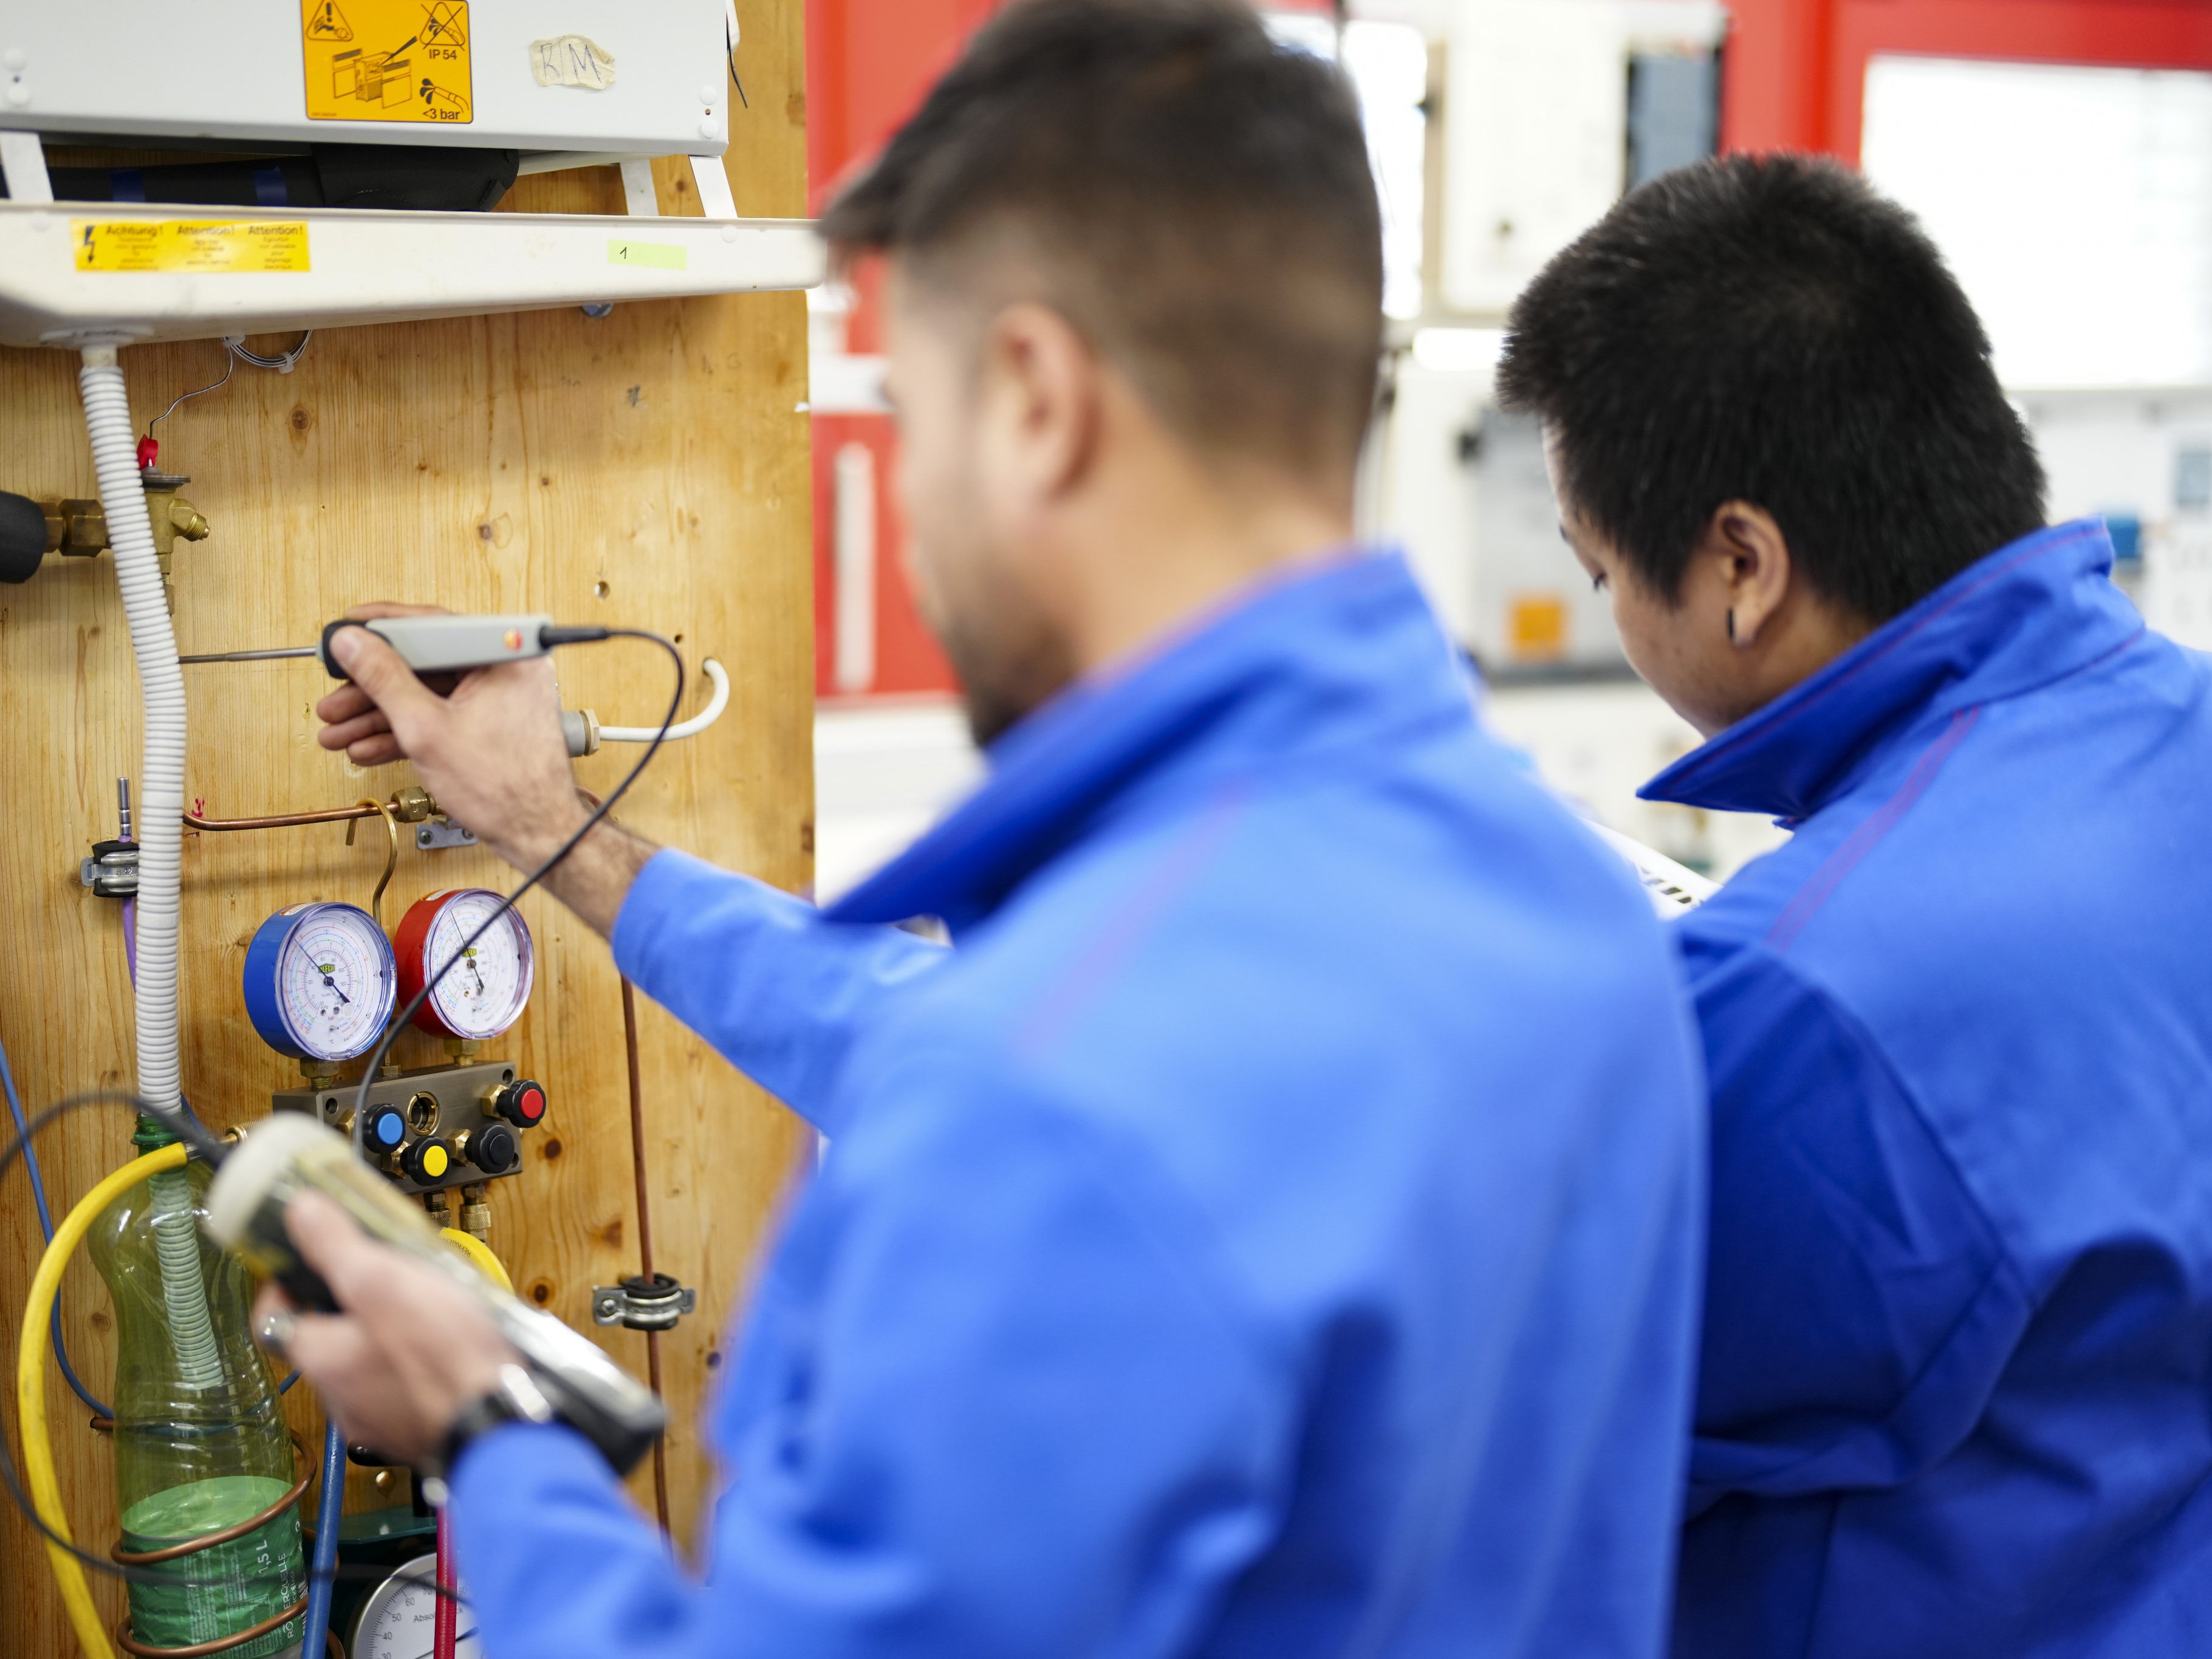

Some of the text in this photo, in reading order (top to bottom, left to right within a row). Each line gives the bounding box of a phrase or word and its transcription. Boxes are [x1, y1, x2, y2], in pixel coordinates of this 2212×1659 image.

[429, 49, 457, 60] IP 54
[422, 108, 461, 120] <3 bar
[247, 225, 303, 235] Attention!
[620, 247, 627, 259] 1
[405, 1597, 416, 1607] 60
[392, 1612, 402, 1623] 50
[383, 1631, 393, 1641] 40
